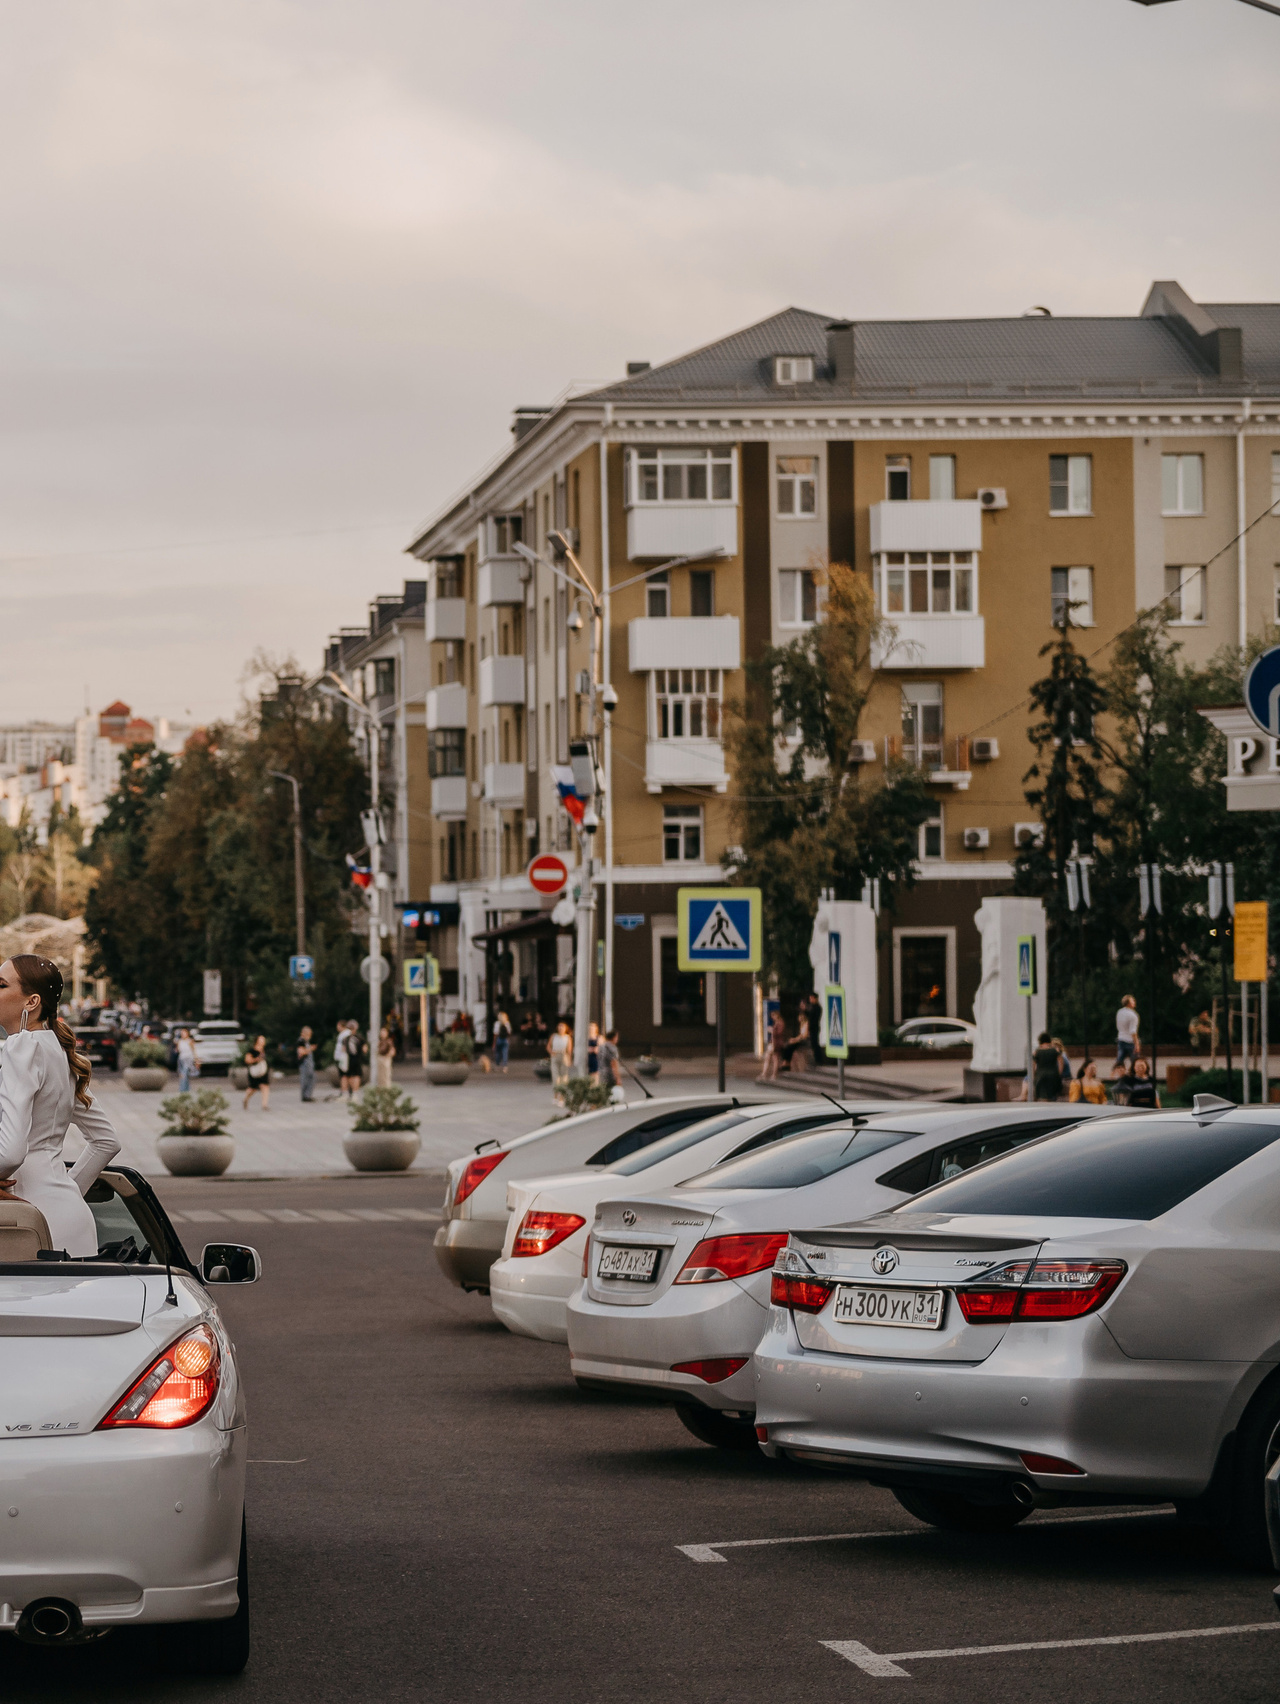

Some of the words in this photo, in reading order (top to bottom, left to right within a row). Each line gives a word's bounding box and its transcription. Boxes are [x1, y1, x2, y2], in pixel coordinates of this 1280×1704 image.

[641, 1251, 654, 1267] 31
[916, 1294, 935, 1315] 31
[914, 1314, 928, 1322] RUS
[5, 1424, 32, 1432] V6
[39, 1422, 79, 1431] SLE
